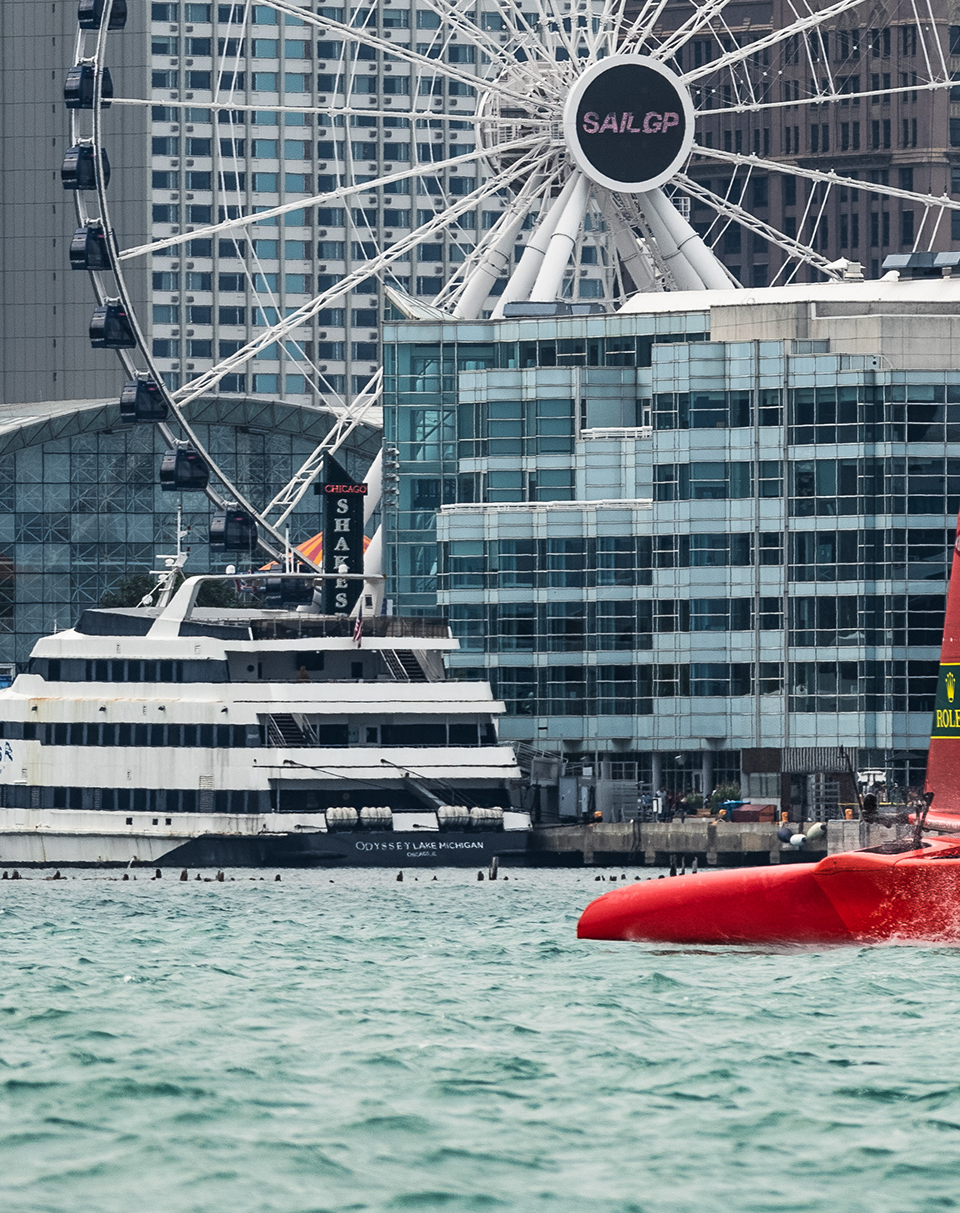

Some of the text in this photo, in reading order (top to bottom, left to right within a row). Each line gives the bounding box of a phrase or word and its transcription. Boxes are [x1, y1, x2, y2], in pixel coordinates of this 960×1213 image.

[324, 484, 367, 493] CHICAGO
[355, 841, 484, 851] ODYSSEY LAKE MICHIGAN
